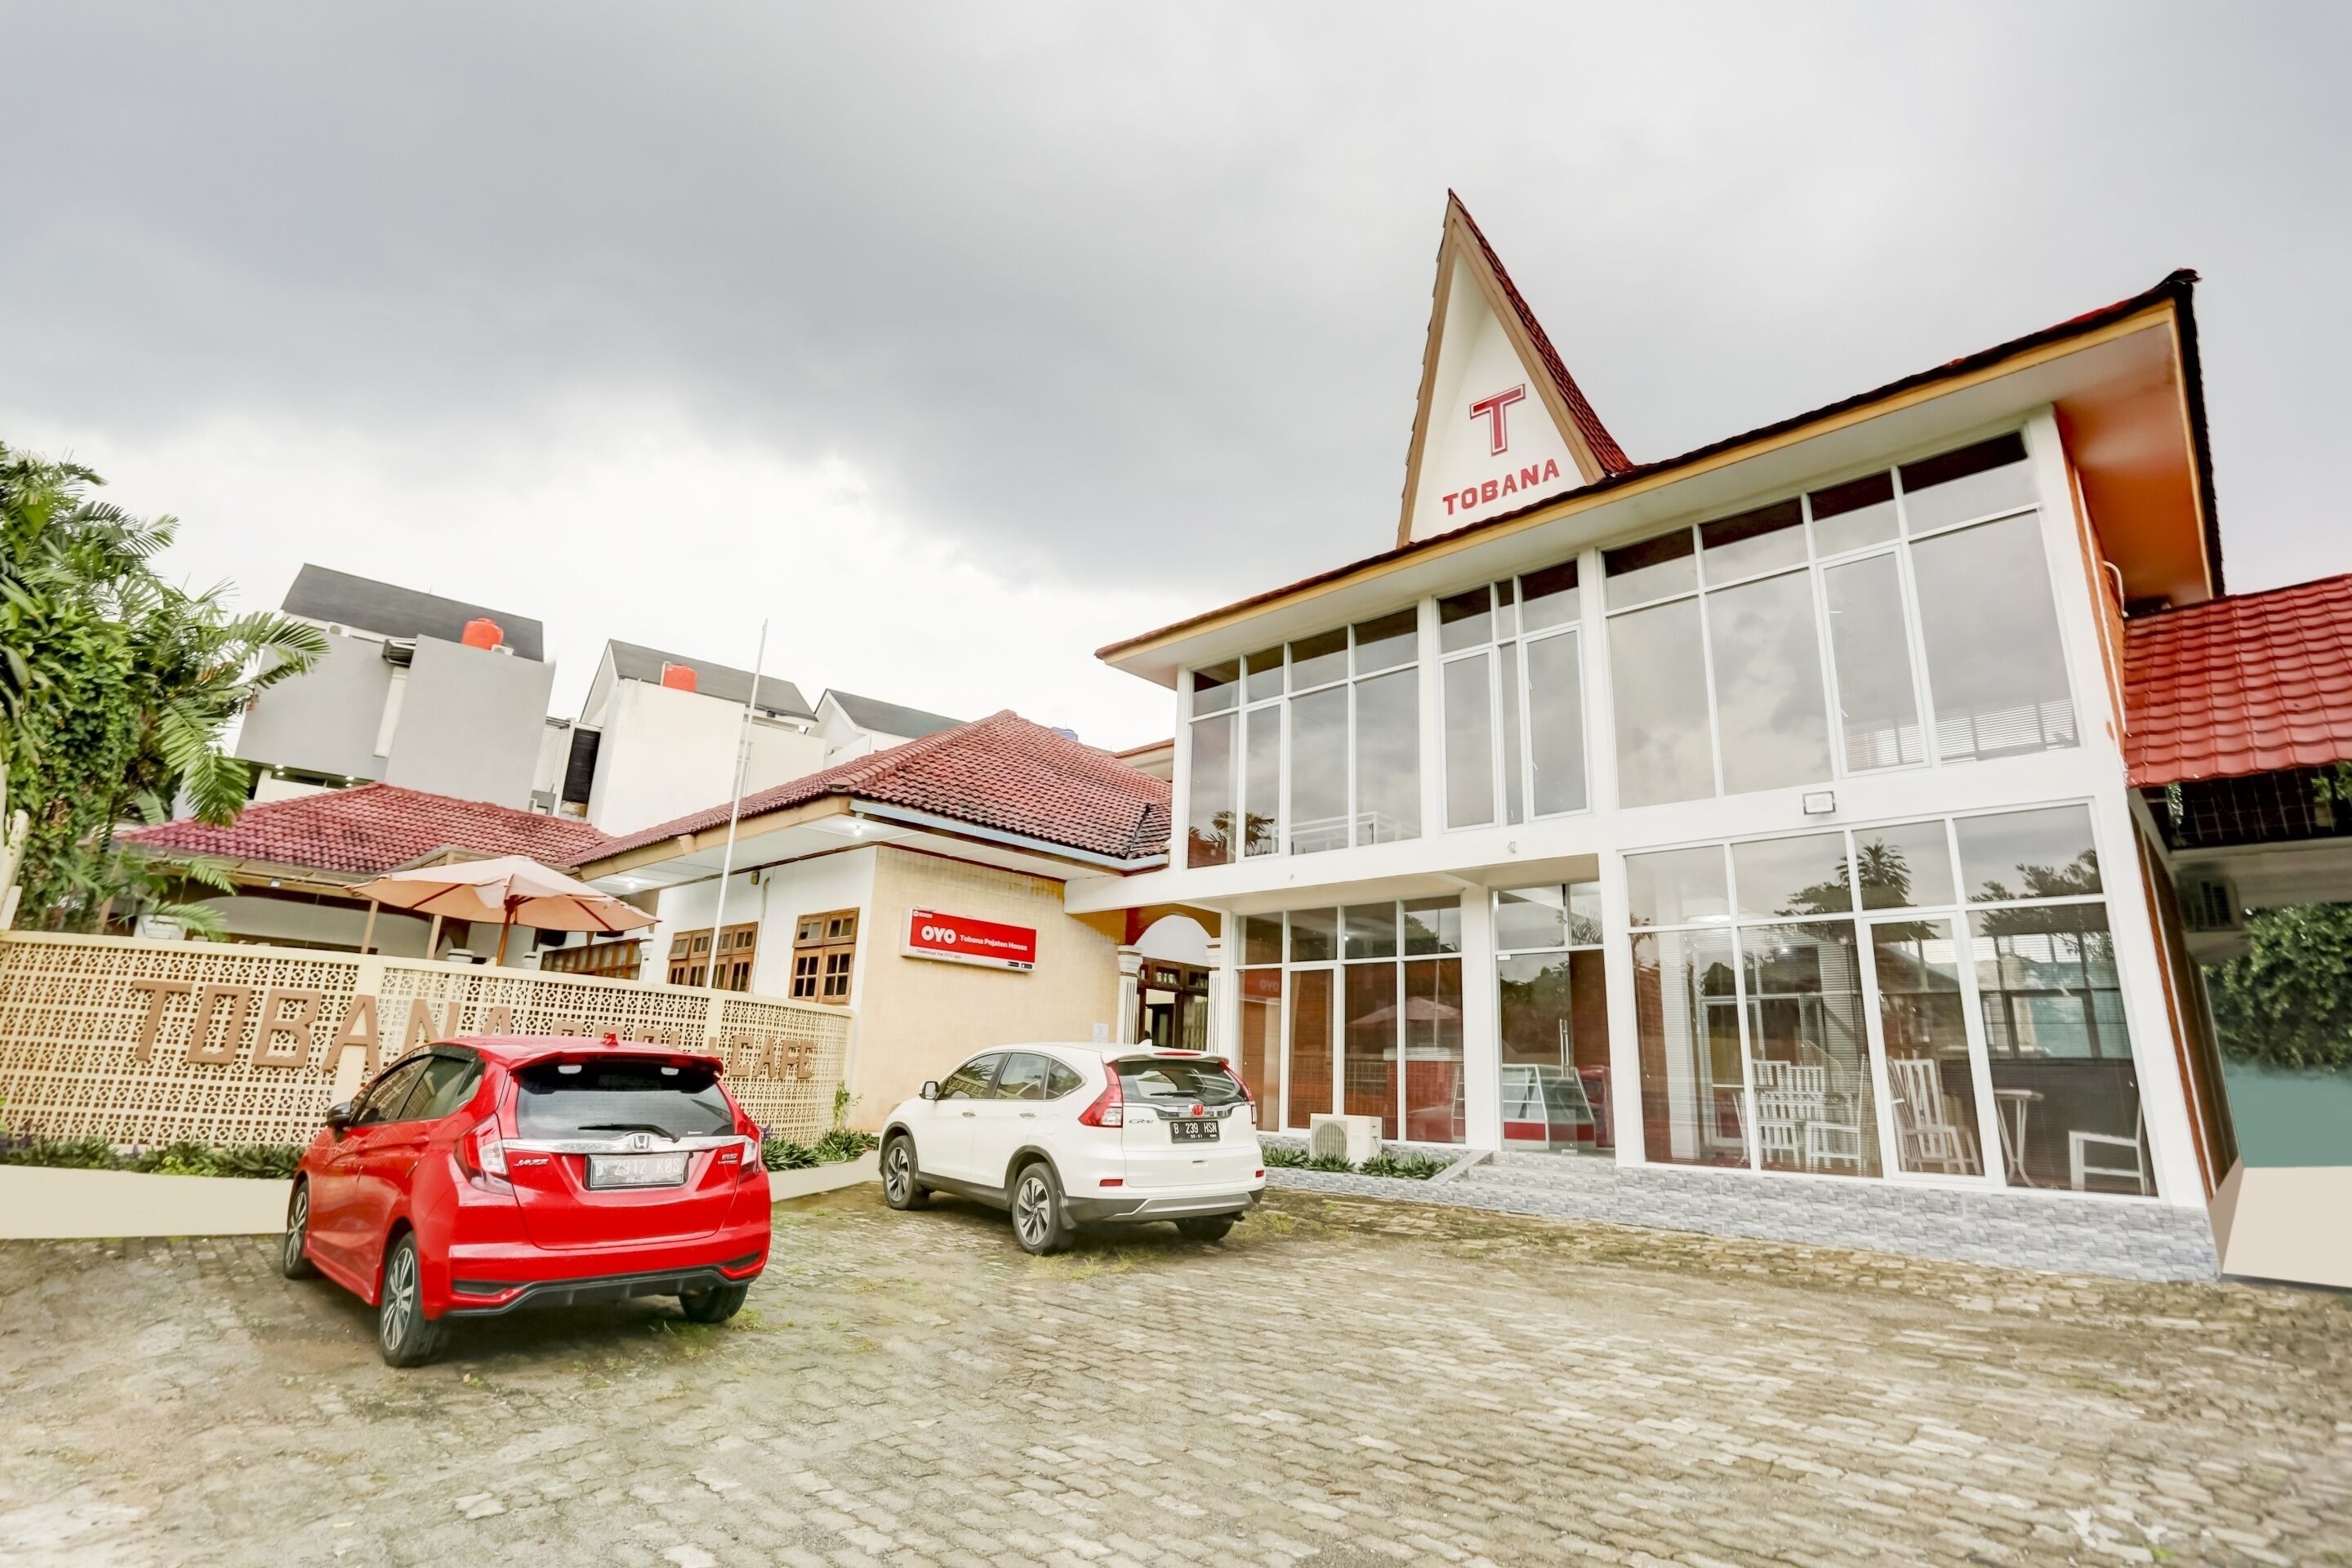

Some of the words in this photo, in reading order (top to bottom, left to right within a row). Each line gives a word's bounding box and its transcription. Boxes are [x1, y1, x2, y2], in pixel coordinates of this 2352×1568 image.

[1470, 384, 1526, 457] T
[1442, 459, 1560, 515] TOBANA
[921, 925, 956, 944] OYO
[959, 934, 983, 944] Tobana
[984, 938, 1008, 947] Pejaten
[1008, 942, 1028, 951] House
[729, 1034, 815, 1079] CAFE
[1173, 1122, 1179, 1134] B
[1185, 1122, 1199, 1134] 239
[1203, 1121, 1218, 1134] HSN
[513, 1158, 550, 1166] JAZZ
